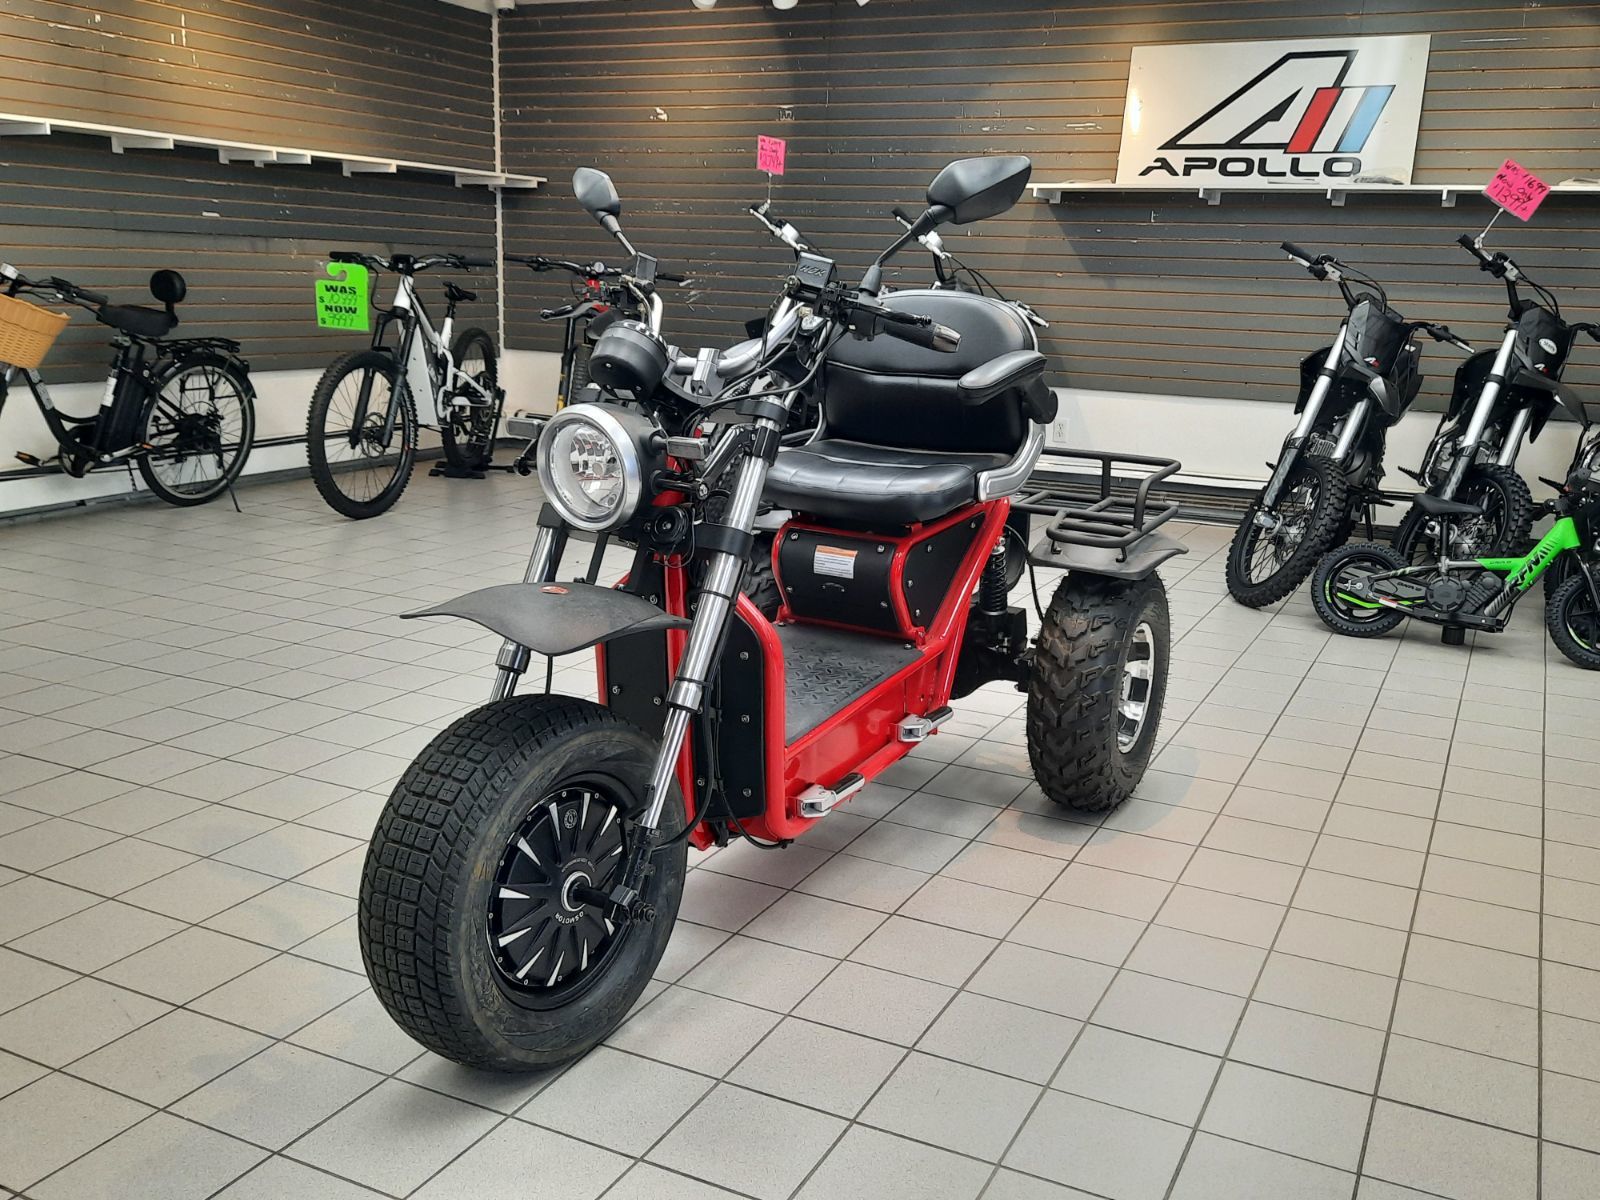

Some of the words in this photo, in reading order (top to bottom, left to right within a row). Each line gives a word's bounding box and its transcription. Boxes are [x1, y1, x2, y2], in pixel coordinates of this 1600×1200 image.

[1138, 157, 1362, 177] APOLLO
[324, 284, 357, 295] WAS
[324, 304, 357, 315] NOW
